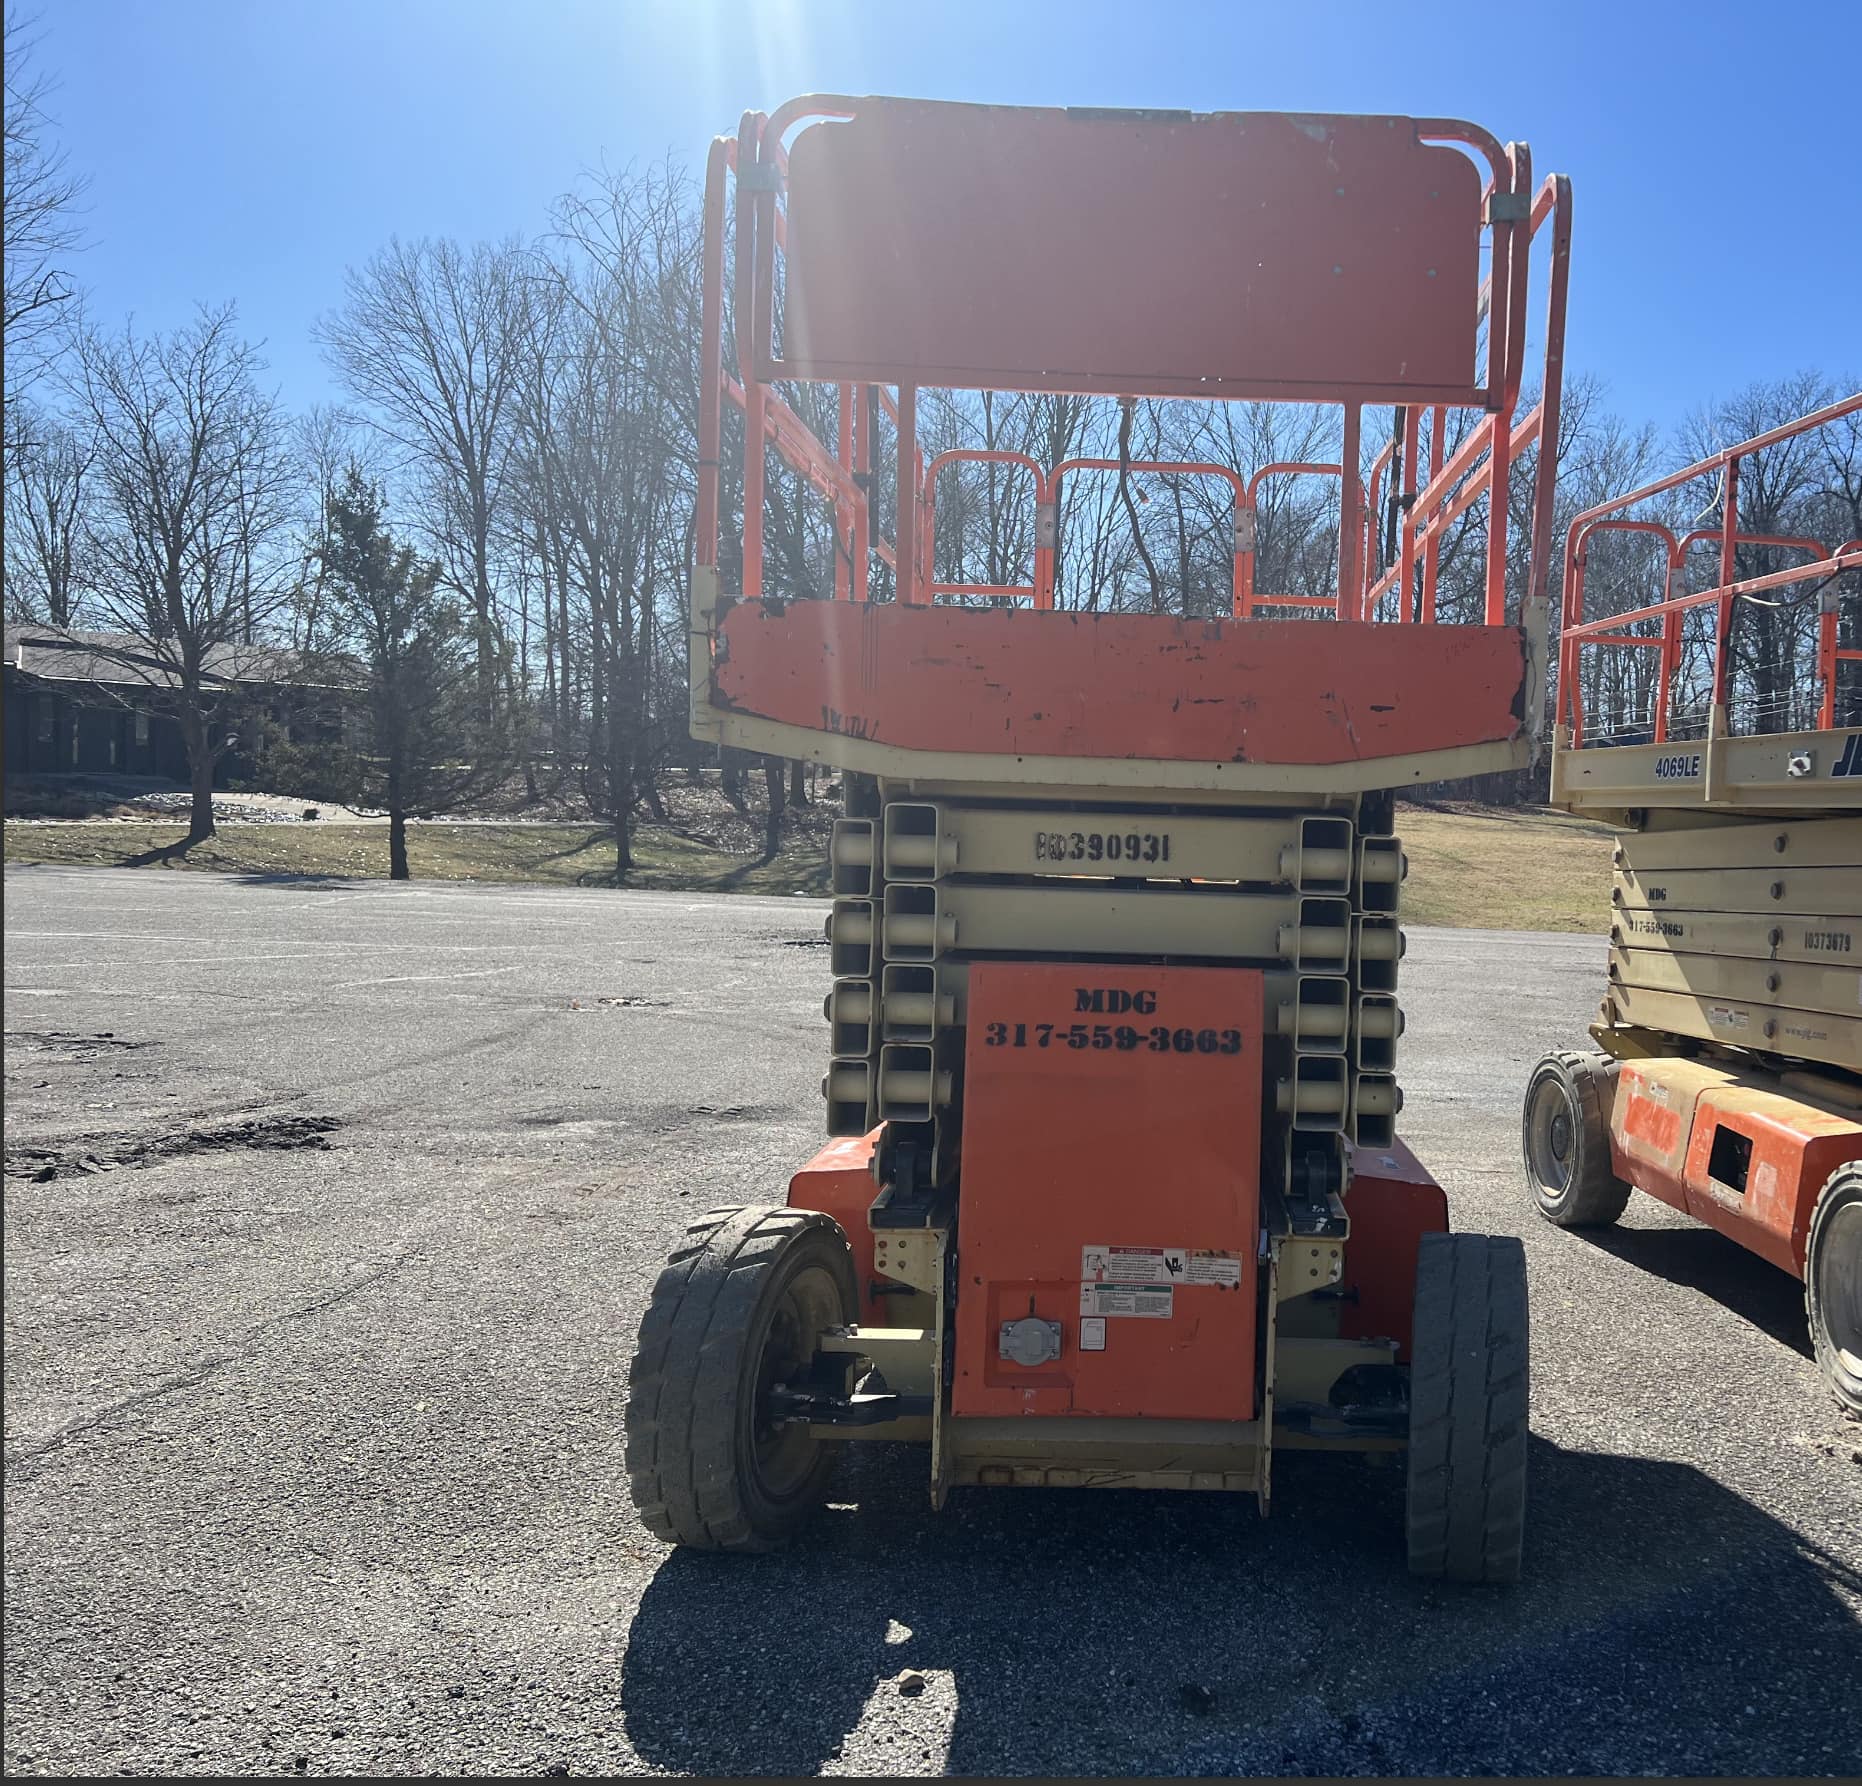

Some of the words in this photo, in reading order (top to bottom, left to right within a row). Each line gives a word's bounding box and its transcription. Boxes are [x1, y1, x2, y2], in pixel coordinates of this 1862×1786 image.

[1655, 755, 1701, 778] 4069LE
[1648, 887, 1667, 901] MDG
[1629, 920, 1684, 937] 317-559-3663
[1074, 988, 1157, 1014] MDG
[985, 1022, 1242, 1055] 317-559-3663
